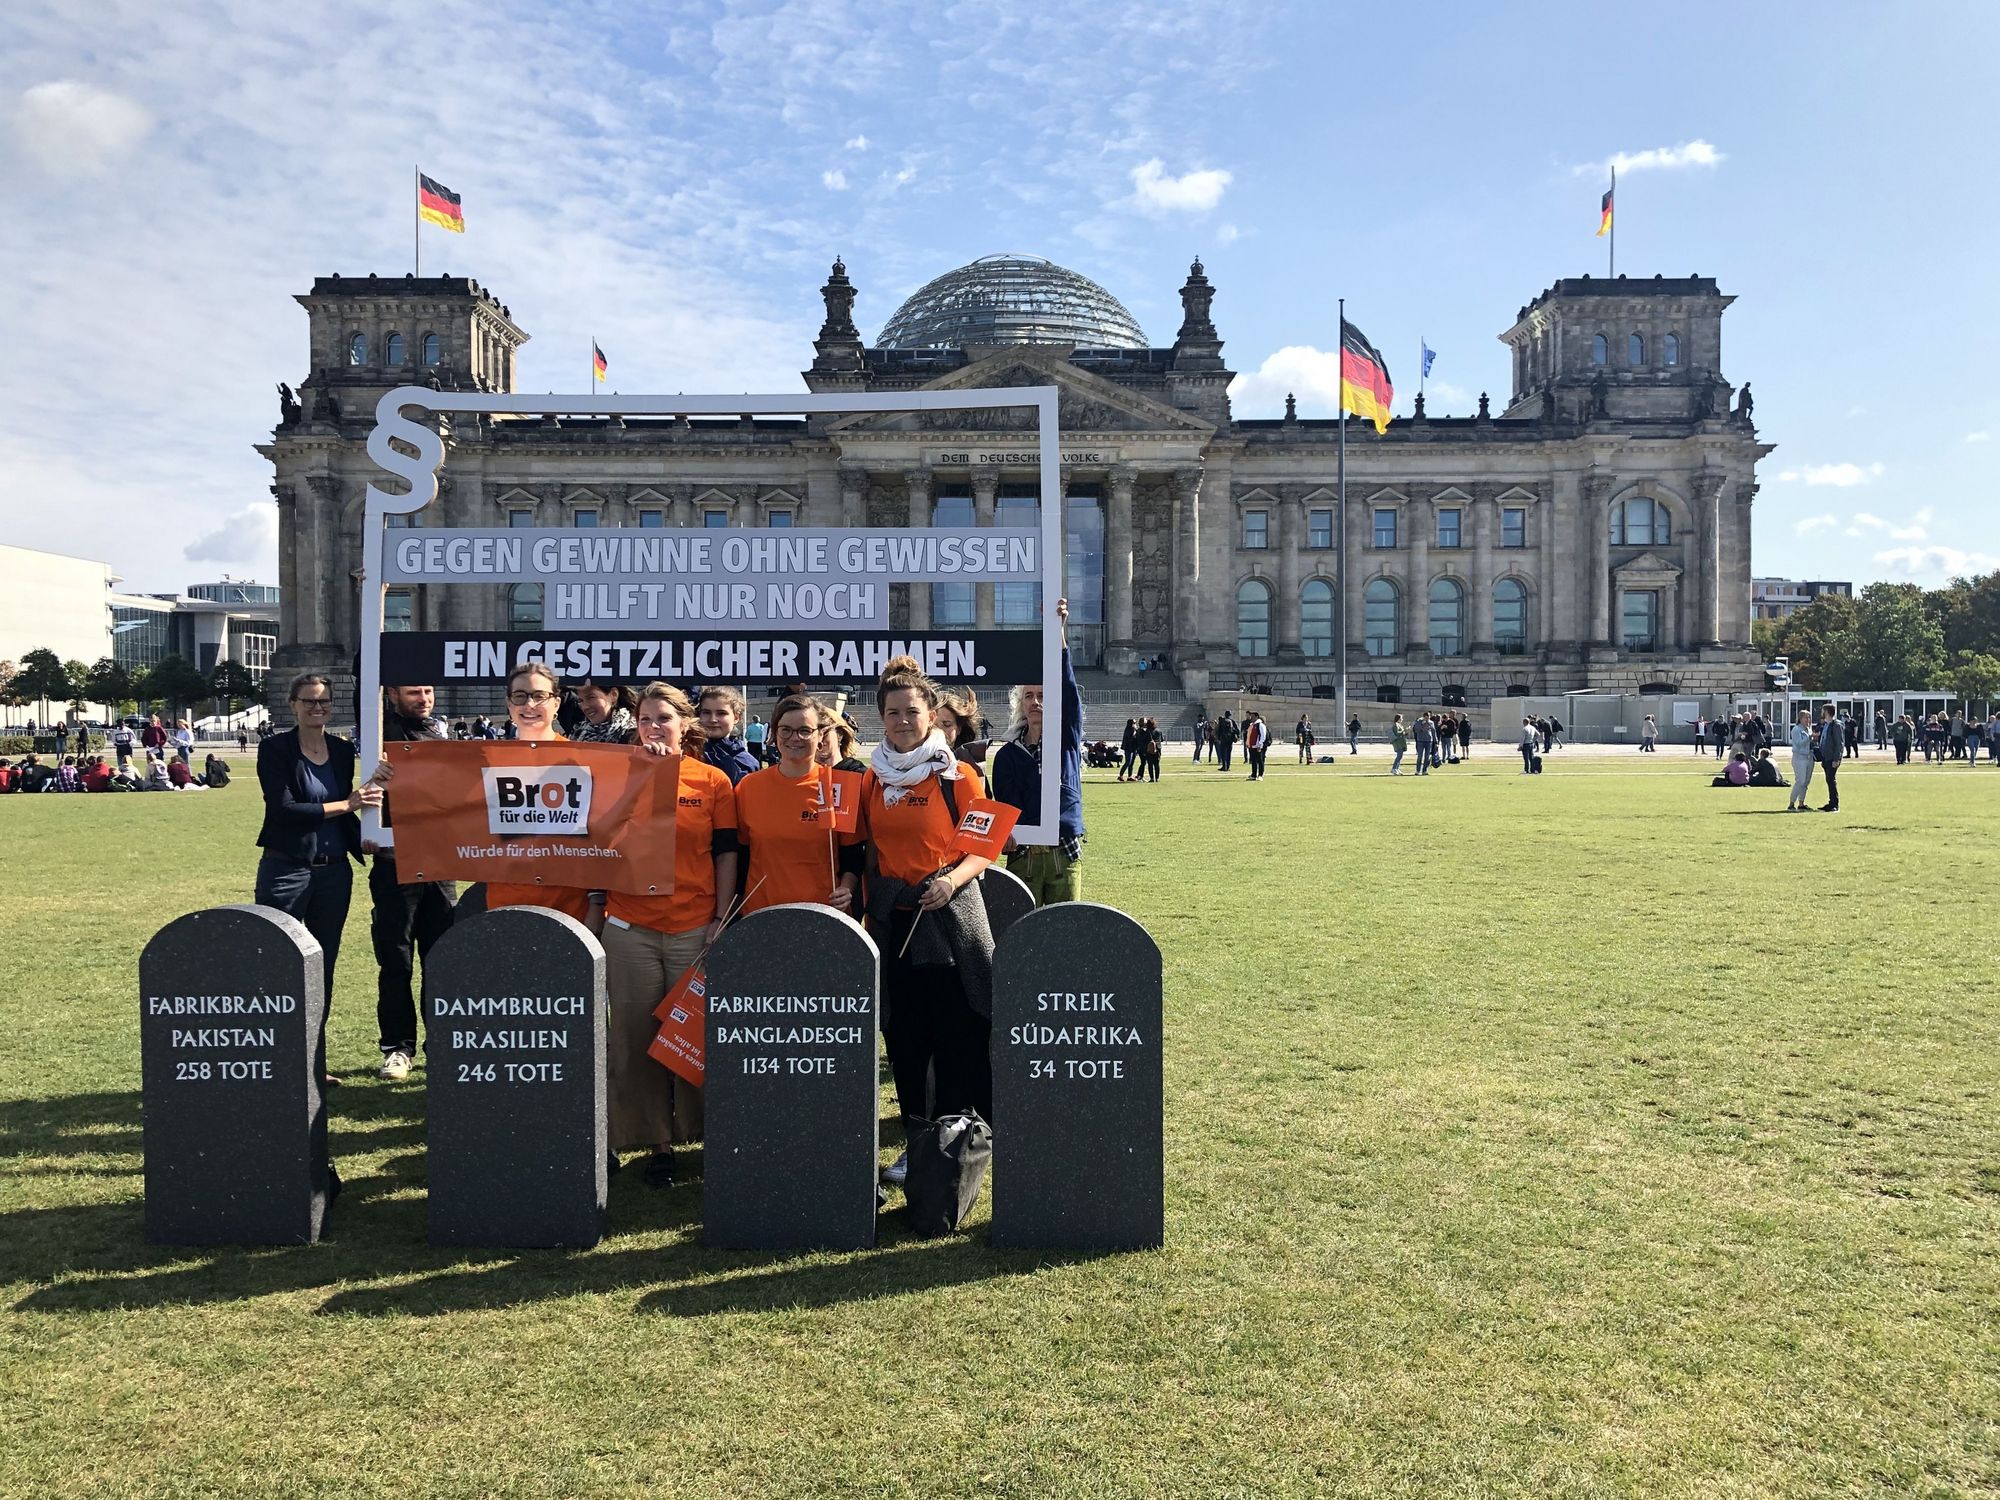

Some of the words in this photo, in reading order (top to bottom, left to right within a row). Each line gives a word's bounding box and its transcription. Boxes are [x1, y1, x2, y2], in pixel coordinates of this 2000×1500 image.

[941, 454, 969, 463] DEM
[1062, 453, 1099, 463] VOLKE
[396, 537, 522, 574] GEGEN
[532, 537, 712, 574] GEWINNE
[721, 537, 829, 574] OHNE
[837, 536, 1036, 574] GEWISSEN
[555, 583, 666, 619] HILFT
[674, 583, 757, 620] NUR
[767, 582, 876, 620] NOCH
[444, 641, 507, 677] EIN
[516, 640, 798, 677] GESETZLICHER
[496, 776, 582, 809] Brot
[678, 796, 703, 805] Brot
[499, 810, 519, 824] für
[523, 810, 545, 824] die
[549, 810, 579, 824] Welt
[965, 814, 990, 826] Brot
[456, 845, 503, 860] Würde
[506, 844, 525, 858] für
[526, 844, 551, 858] den
[552, 843, 623, 859] Menschen.
[149, 995, 296, 1015] FABRIKBRAND
[434, 997, 585, 1016] DAMMBRUCH
[709, 996, 871, 1013] FABRIKEINSTURZ
[1037, 992, 1116, 1012] STREIK
[172, 1028, 275, 1048] PAKISTAN
[452, 1030, 568, 1049] BRASILIEN
[717, 1027, 862, 1044] BANGLADESCH
[1010, 1022, 1143, 1045] SÜDAFRIKA
[175, 1061, 212, 1080] 258
[217, 1060, 273, 1080] TOTE
[457, 1063, 497, 1082] 246
[504, 1063, 564, 1083] TOTE
[742, 1057, 780, 1074] 1134
[786, 1057, 836, 1074] TOTE
[1029, 1060, 1057, 1079] 34
[1064, 1060, 1124, 1079] TOTE
